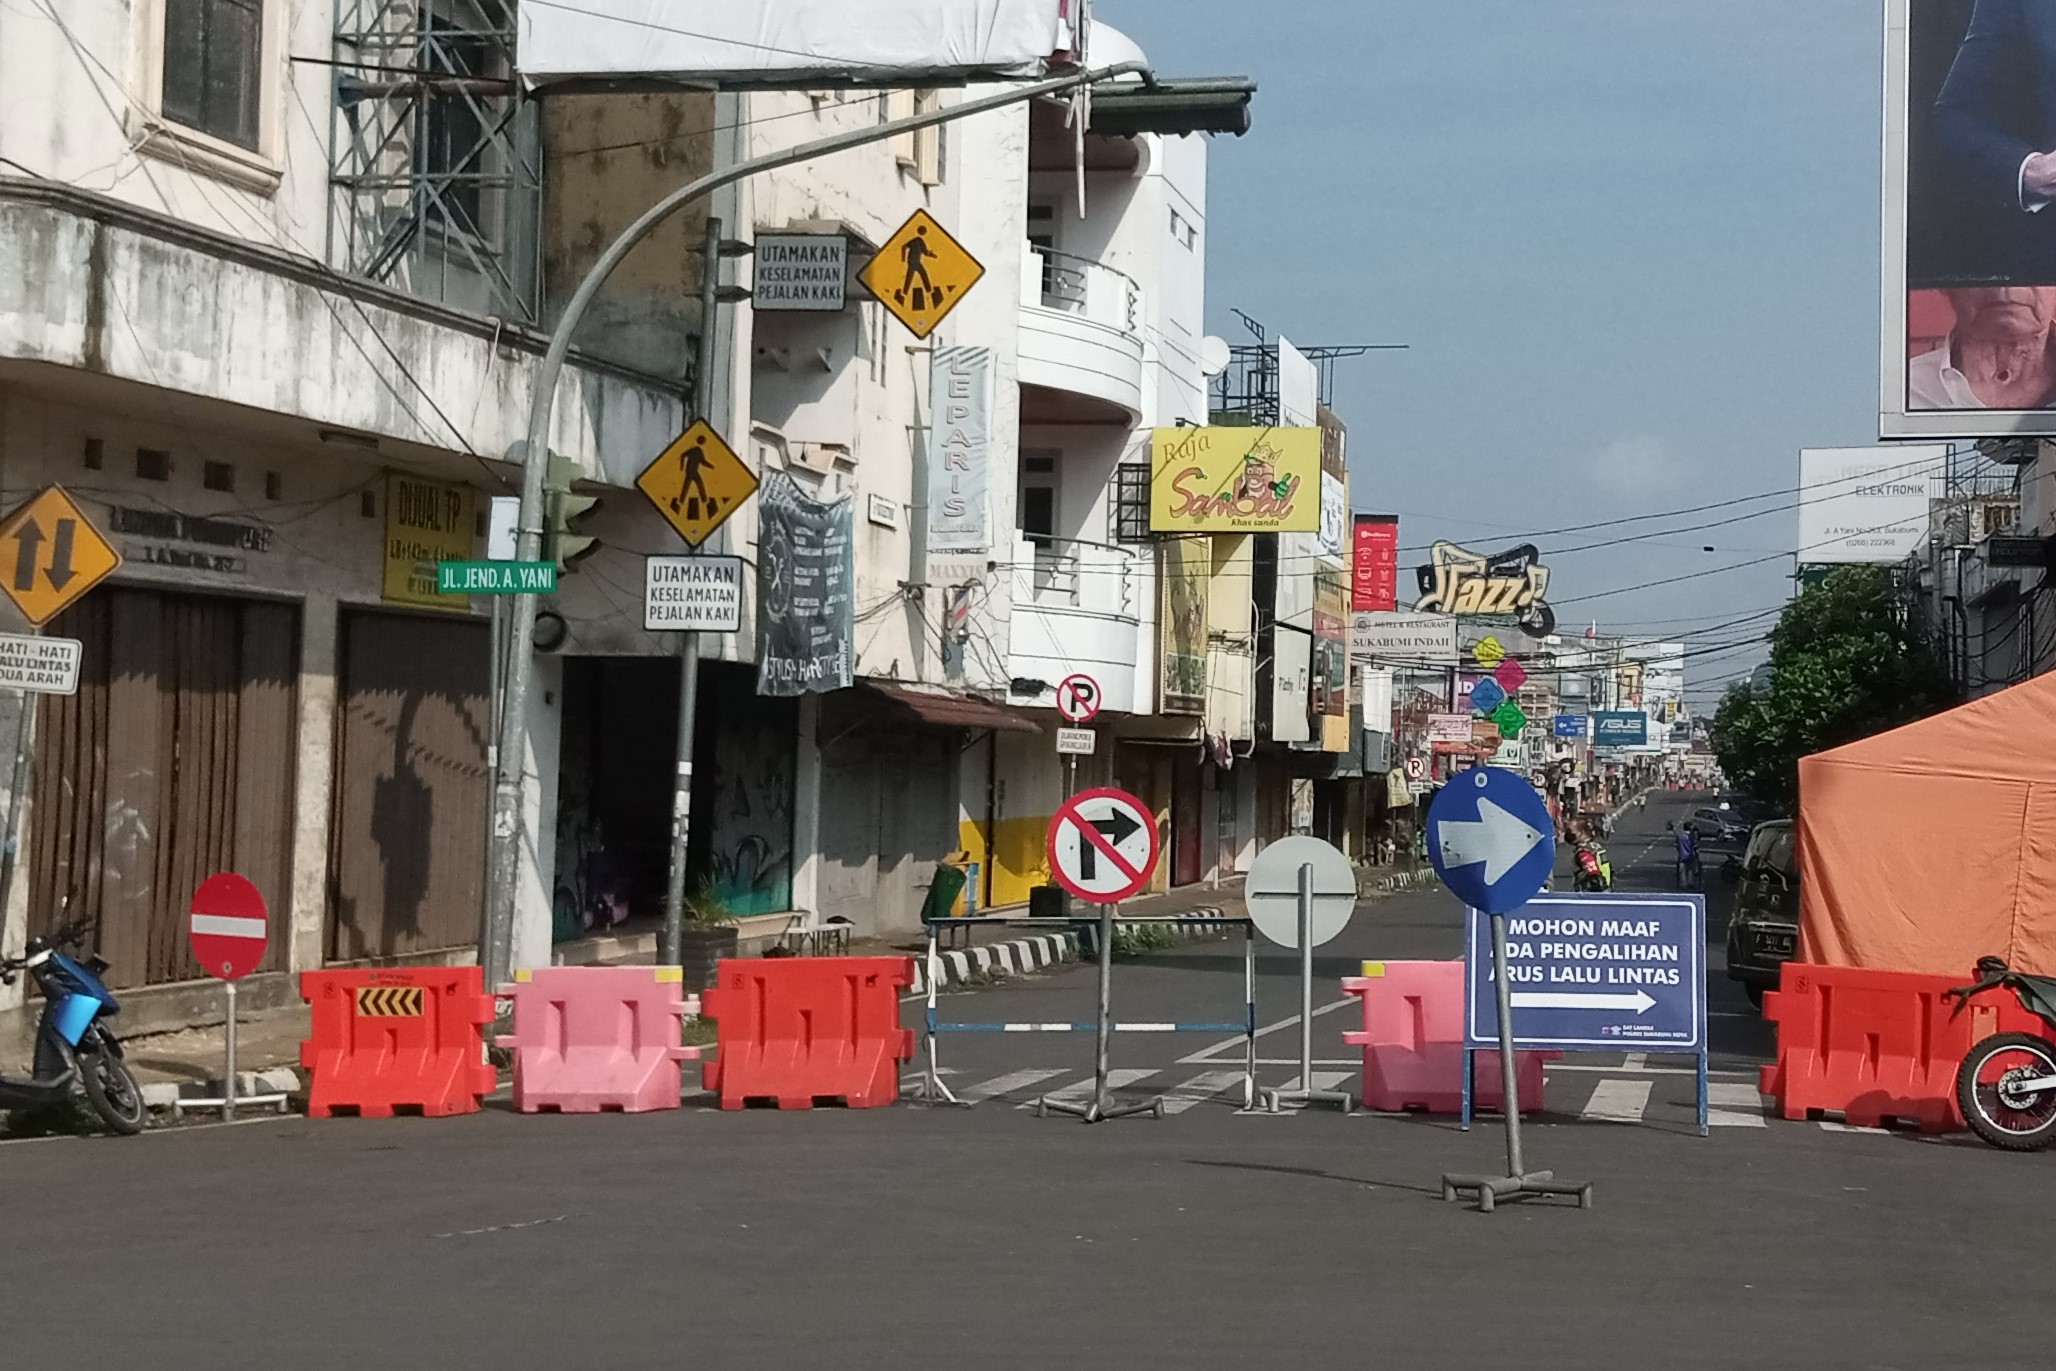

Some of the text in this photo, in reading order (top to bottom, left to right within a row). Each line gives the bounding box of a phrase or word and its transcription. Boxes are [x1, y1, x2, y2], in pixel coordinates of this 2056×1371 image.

[762, 245, 839, 262] UTAMAKAN
[759, 267, 841, 282] KESELAMATAN
[758, 285, 841, 299] PEJALAN KAKI
[1162, 432, 1212, 463] Raja
[1168, 466, 1301, 521] Sambal
[1855, 484, 1925, 496] ELEKTRONIK
[443, 567, 461, 589] JL.
[464, 567, 501, 589] JEND.
[503, 567, 517, 589] A.
[519, 567, 552, 589] YANI
[653, 565, 735, 583] UTAMAKAN
[1411, 540, 1527, 614] Jazz
[650, 587, 735, 603] KESELAMATAN
[649, 605, 735, 621] PEJALAN KAKI
[1406, 621, 1450, 629] RESTAURANT
[1353, 637, 1449, 647] SUKABUMI INDAH
[39, 645, 72, 659] HATI
[26, 658, 71, 672] LINTAS
[27, 671, 64, 685] ARAH
[1600, 719, 1642, 729] ASUS
[1509, 919, 1660, 937] MOHON MAAF
[1540, 943, 1678, 961] PENGALIHAN
[1550, 967, 1600, 983] LALU
[1608, 968, 1680, 985] LINTAS
